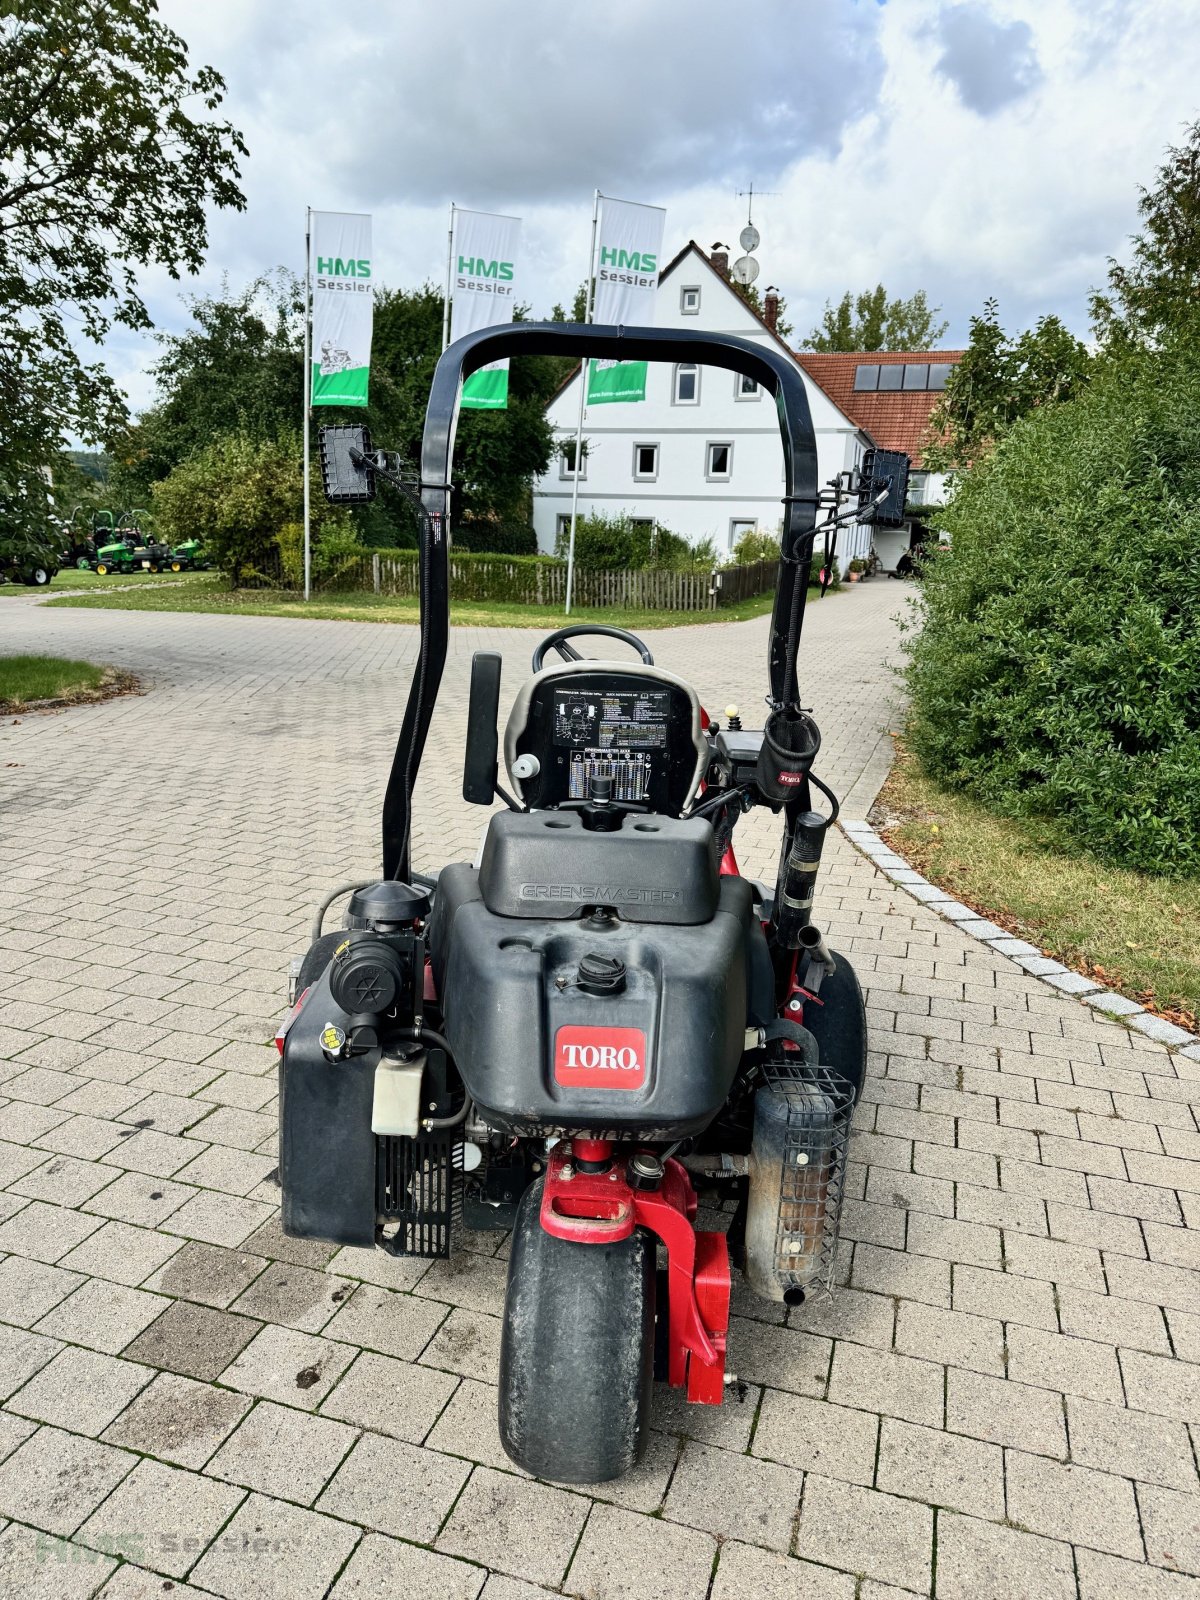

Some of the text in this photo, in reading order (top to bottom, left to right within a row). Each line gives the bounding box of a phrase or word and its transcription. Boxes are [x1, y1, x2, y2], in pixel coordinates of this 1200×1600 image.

[317, 256, 371, 278] HMS
[458, 255, 514, 281] HMS
[601, 246, 657, 273] HMS
[317, 278, 371, 292] Sessler
[457, 278, 513, 295] Sessler
[600, 269, 655, 287] Sessler
[522, 885, 675, 902] GREENSMASTER
[562, 1045, 638, 1070] TORO
